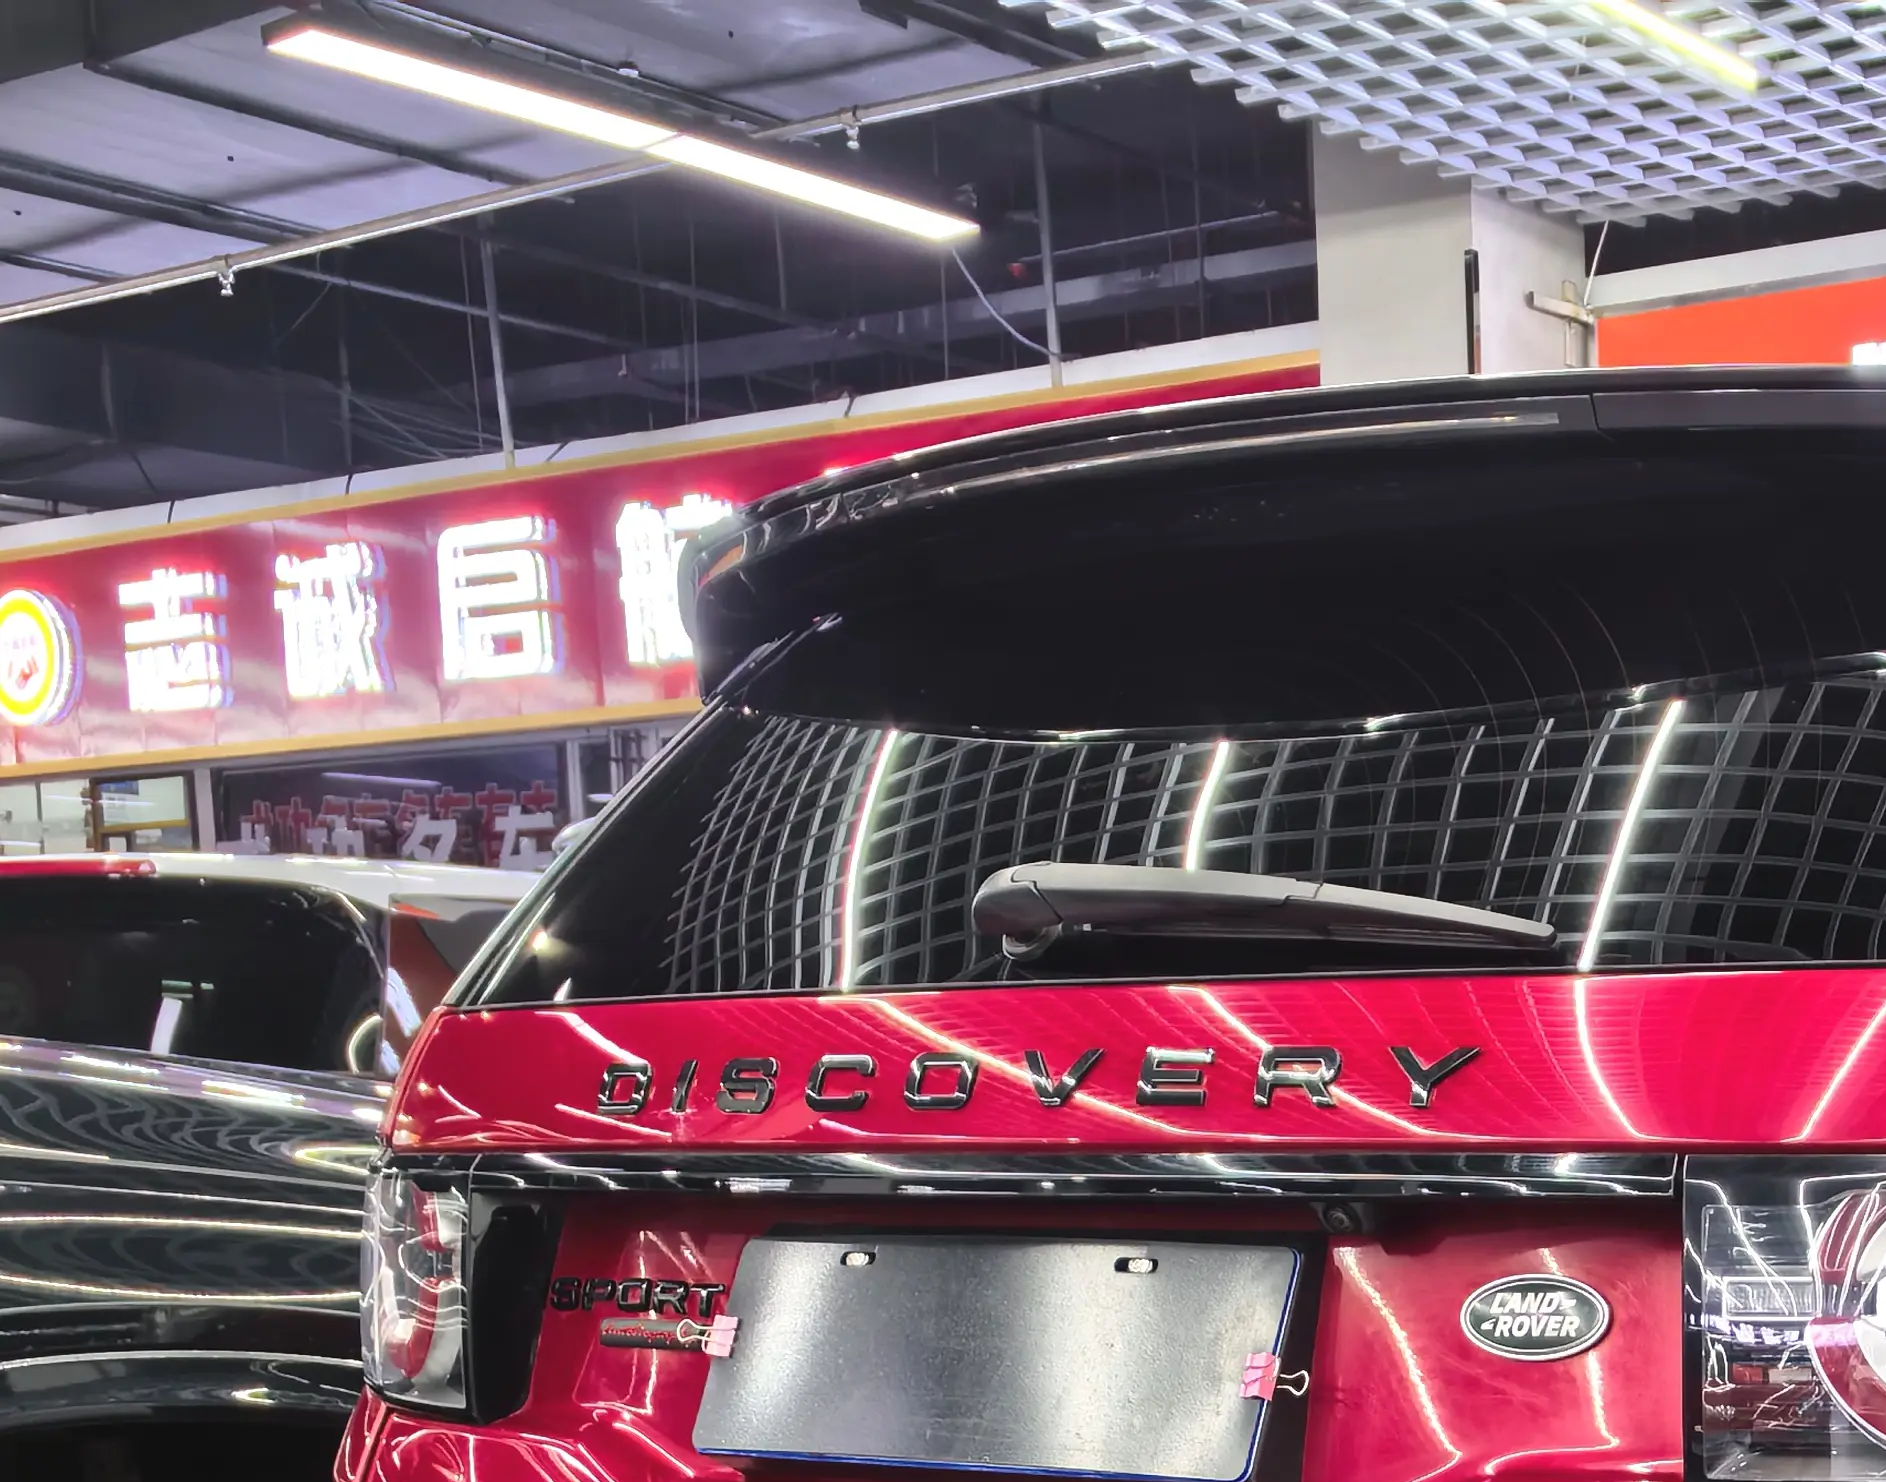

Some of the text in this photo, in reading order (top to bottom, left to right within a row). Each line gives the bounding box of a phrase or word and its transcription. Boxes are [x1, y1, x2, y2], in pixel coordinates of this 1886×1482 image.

[598, 1045, 1480, 1115] DISCOVERY
[550, 1277, 726, 1318] SPORT
[1490, 1291, 1560, 1314] LAND
[1493, 1315, 1581, 1338] ROVER
